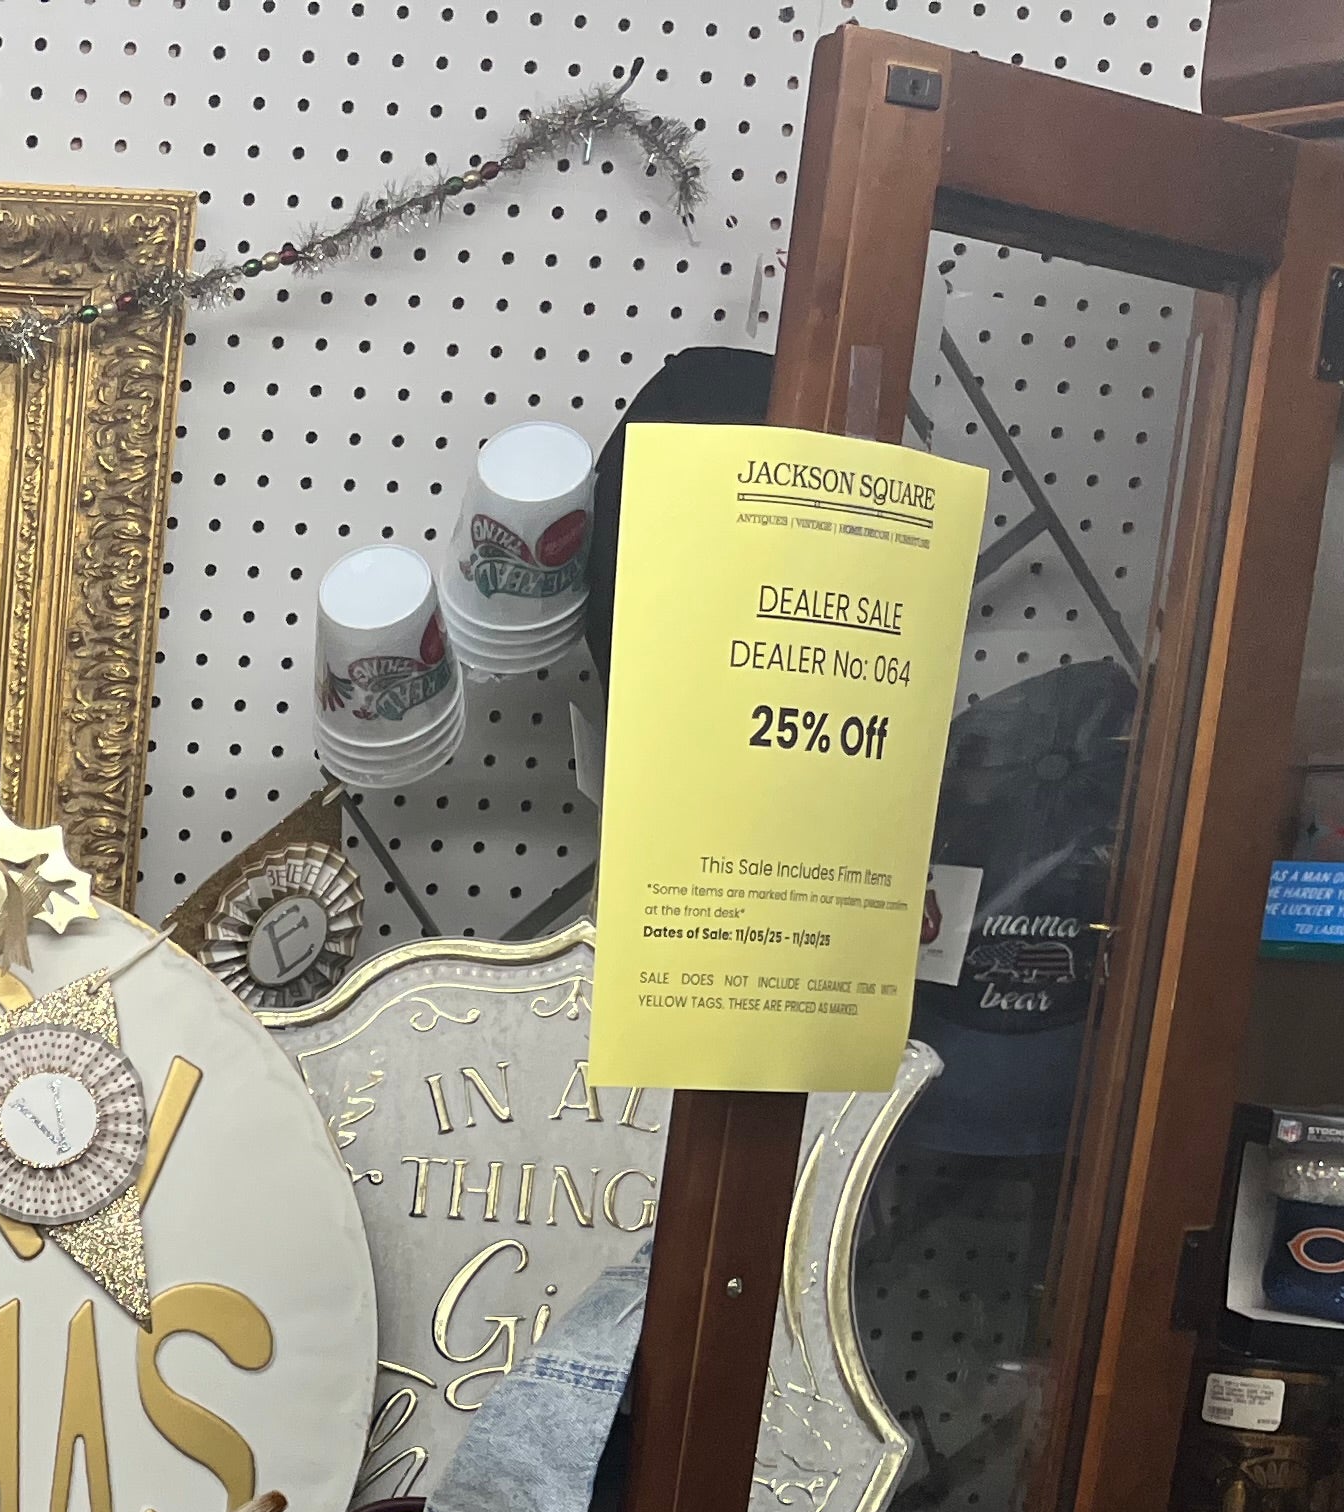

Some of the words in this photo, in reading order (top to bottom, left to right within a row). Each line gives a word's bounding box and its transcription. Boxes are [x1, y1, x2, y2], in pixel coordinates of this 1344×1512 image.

[738, 461, 855, 496] JACKSON
[860, 474, 936, 511] SQUARE
[759, 585, 850, 621] DEALER
[857, 597, 903, 630] SALE
[730, 640, 825, 675] DEALER
[833, 650, 868, 681] No:
[874, 655, 910, 687] 064
[748, 705, 830, 754] 25%
[841, 714, 889, 760] Off
[700, 857, 733, 874] This
[739, 859, 772, 876] Sale
[777, 861, 834, 882] Includes
[838, 866, 862, 885] Firm
[864, 869, 893, 888] Items
[691, 884, 723, 898] items
[748, 888, 787, 901] marked
[1283, 887, 1334, 900] HARDER
[661, 905, 681, 917] the
[684, 906, 711, 918] front
[982, 913, 1080, 938] mama
[262, 904, 315, 979] E
[643, 925, 683, 939] Dates
[686, 926, 699, 939] of
[702, 927, 732, 941] Sale:
[735, 926, 782, 946] 11/05/25
[792, 929, 831, 948] 11/30/25
[639, 972, 669, 985] SALE
[681, 973, 713, 986] DOES
[724, 975, 749, 988] NOT
[758, 977, 800, 990] INCLUDE
[638, 994, 687, 1008] YELLOW
[728, 997, 761, 1011] THESE
[763, 999, 782, 1012] ARE
[979, 983, 1052, 1012] bear
[425, 1061, 513, 1135] IN
[9, 1076, 80, 1156] V
[401, 1156, 658, 1233] THING
